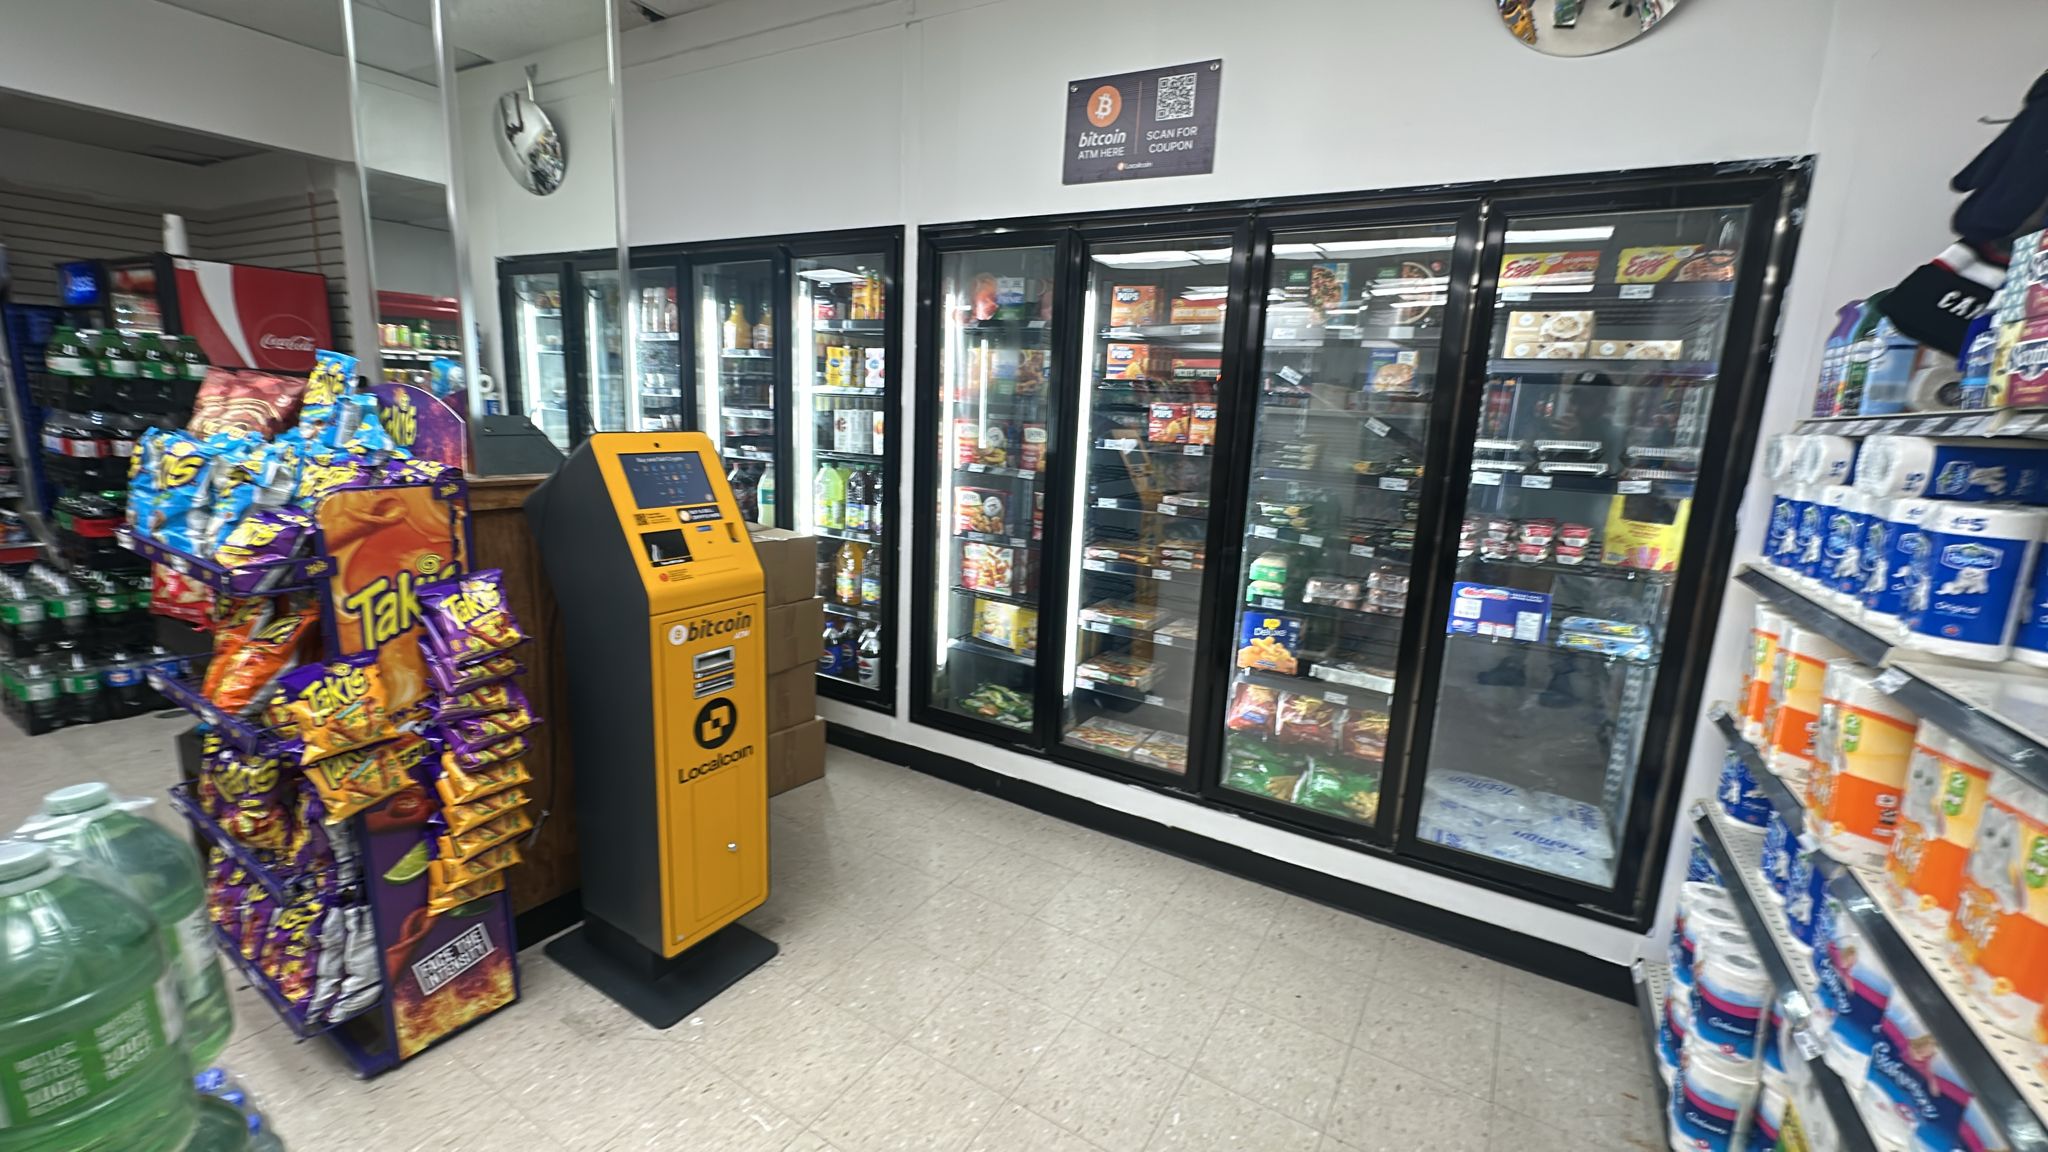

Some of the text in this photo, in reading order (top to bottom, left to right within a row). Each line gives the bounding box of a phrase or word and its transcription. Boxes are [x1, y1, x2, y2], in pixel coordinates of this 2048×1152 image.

[1078, 128, 1127, 147] bitcoin
[1146, 126, 1198, 141] SCAN FOR
[1078, 147, 1125, 160] ATM HERE
[1148, 140, 1193, 154] COUPON
[439, 585, 500, 630] Takis
[687, 611, 752, 642] bitcoin
[299, 667, 369, 727] Takis
[678, 744, 754, 785] Localcoin
